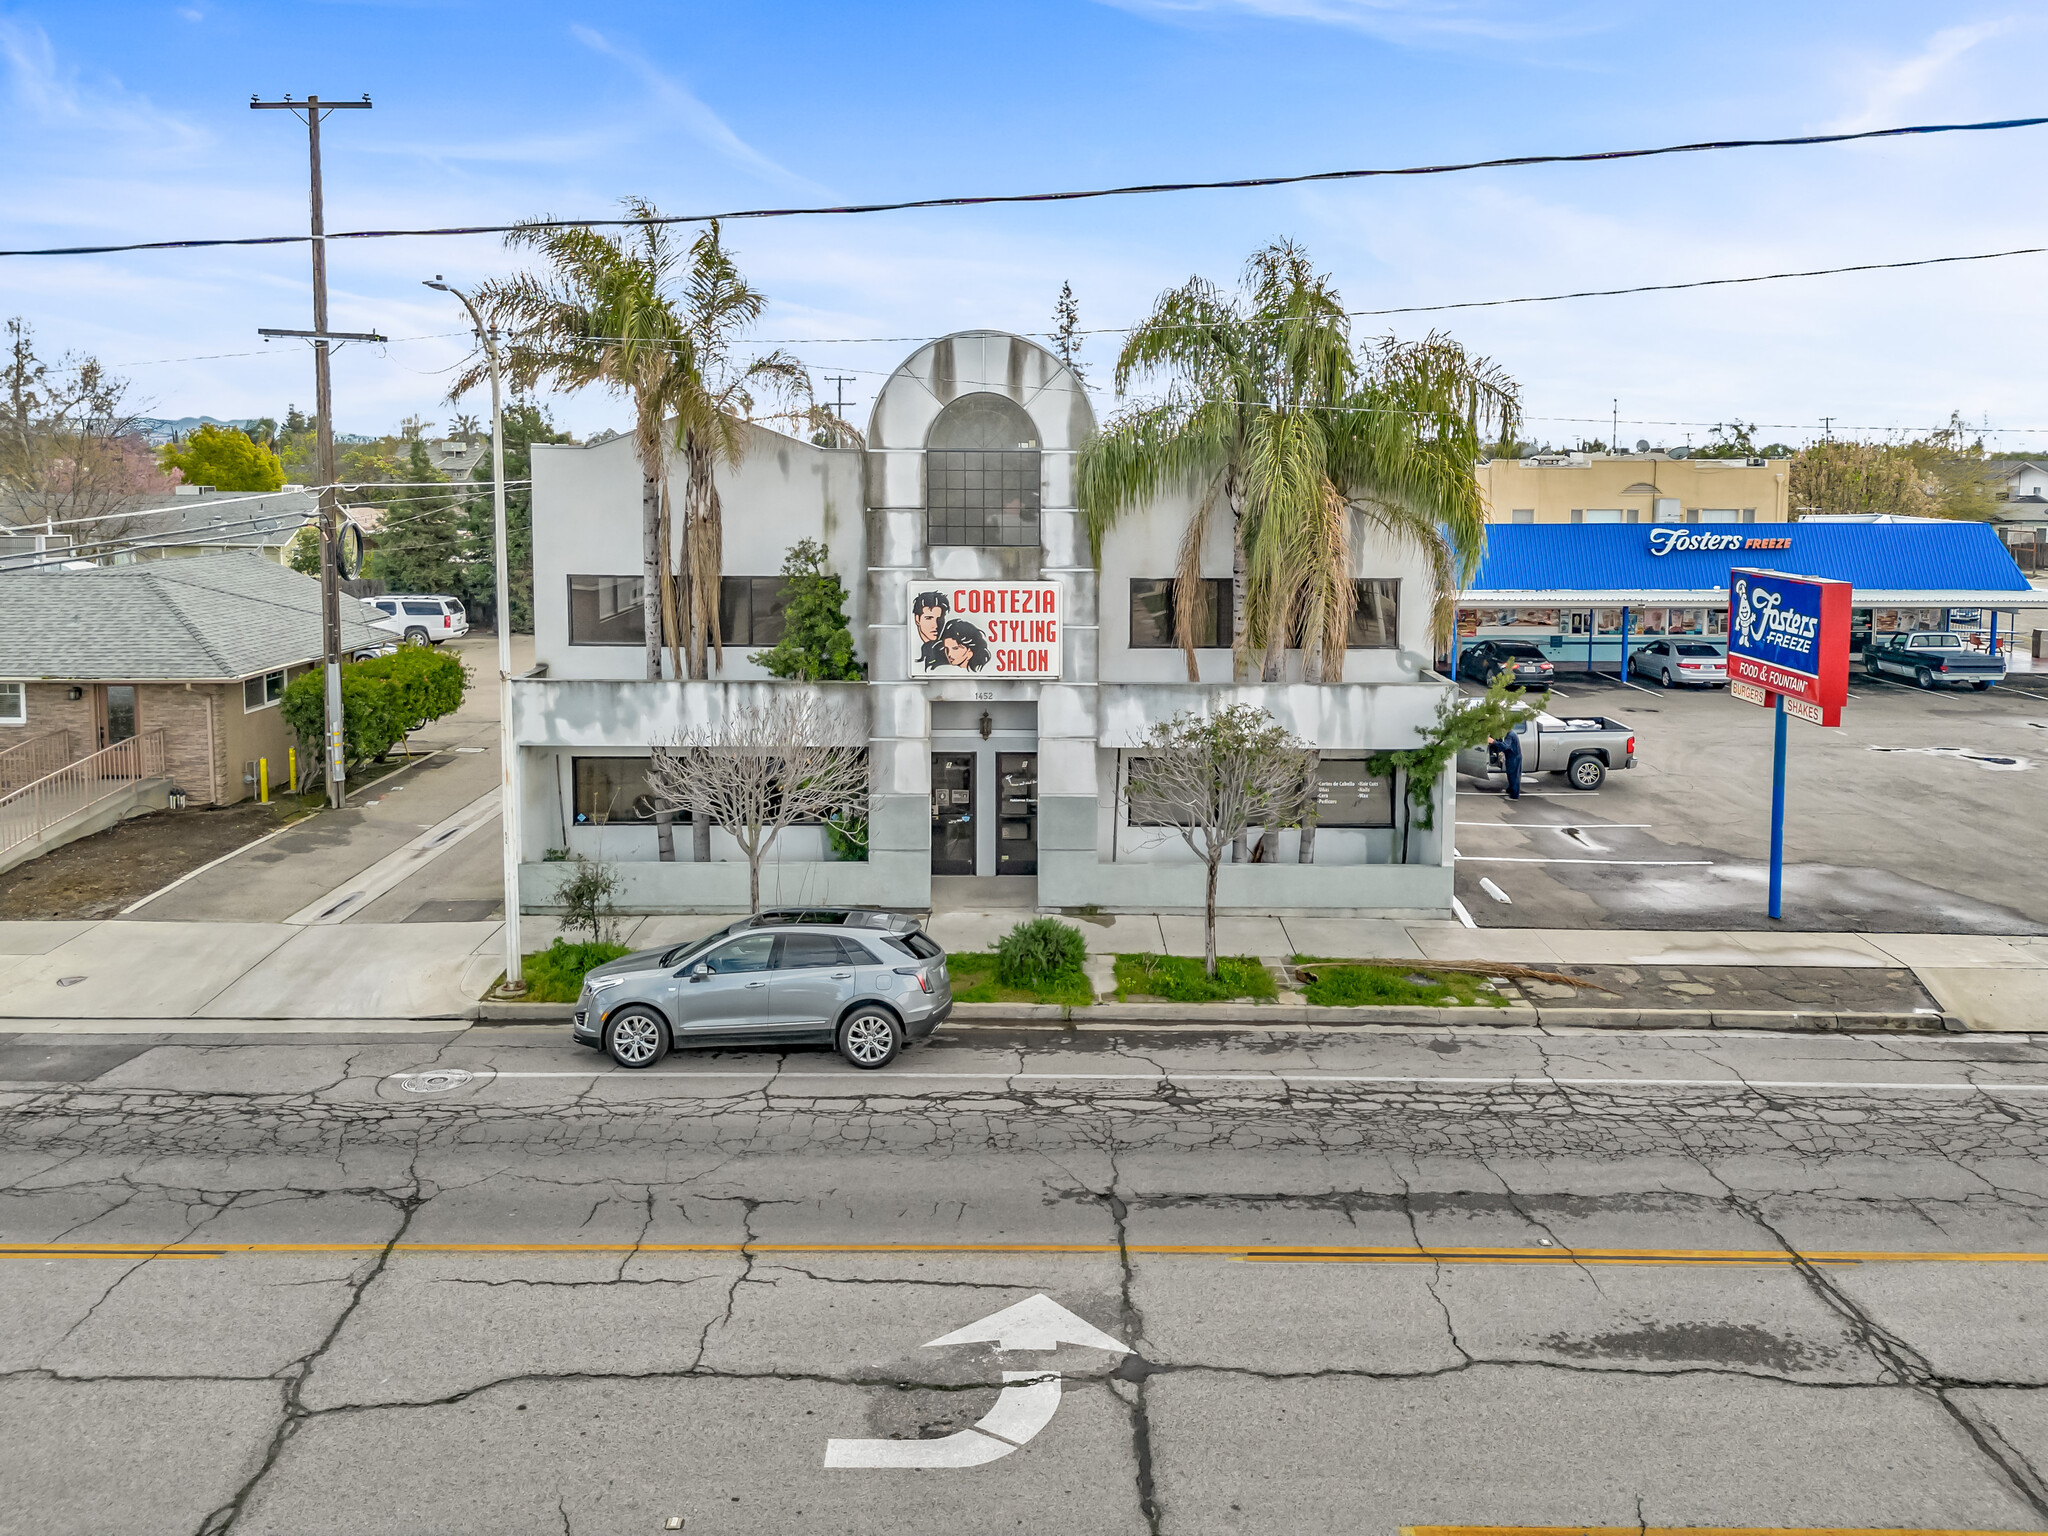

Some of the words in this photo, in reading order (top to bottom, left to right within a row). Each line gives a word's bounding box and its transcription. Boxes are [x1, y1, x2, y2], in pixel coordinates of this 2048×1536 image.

[1650, 527, 1743, 556] Fosters
[1744, 538, 1792, 549] FREEZE
[953, 589, 1055, 613] CORTEZIA
[1750, 587, 1818, 641] Fosters
[988, 620, 1056, 643] STYLING
[1766, 631, 1812, 654] FREEZE
[996, 649, 1048, 672] SALON
[1739, 662, 1759, 679] FOOD
[1760, 665, 1768, 682] &
[1768, 671, 1807, 693] FOUNTAIN
[975, 692, 993, 700] 1452
[1733, 682, 1764, 703] BURGERS
[1787, 699, 1819, 721] SHAKES
